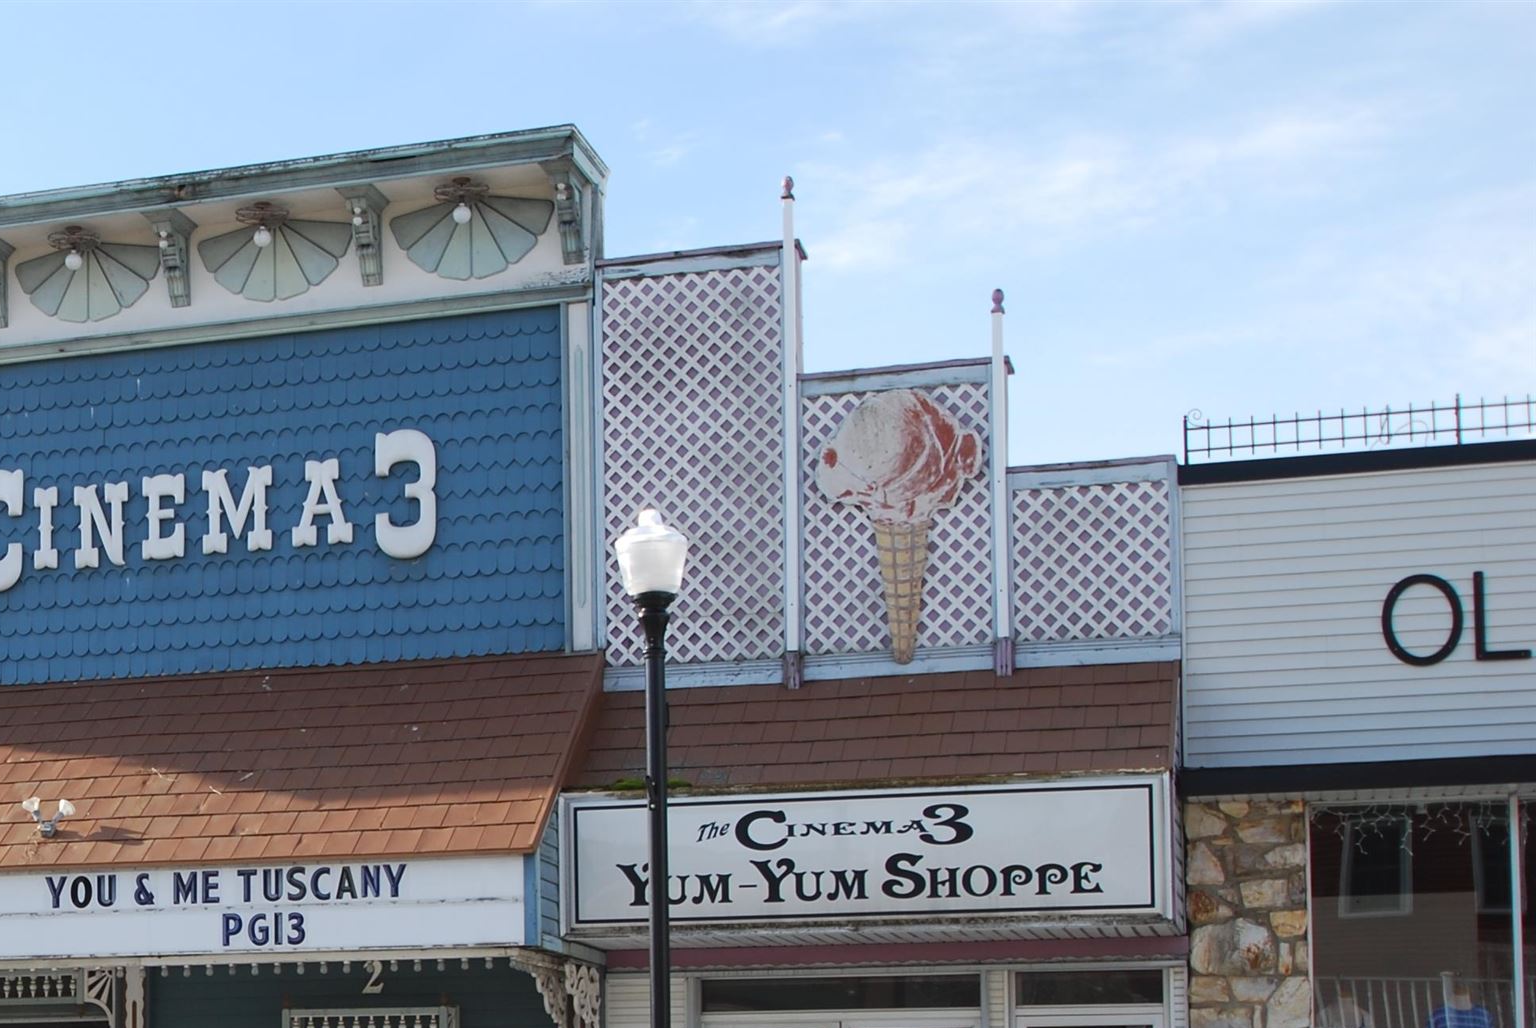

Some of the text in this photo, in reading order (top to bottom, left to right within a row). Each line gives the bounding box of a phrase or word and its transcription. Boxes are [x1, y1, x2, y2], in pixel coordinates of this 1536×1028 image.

[375, 428, 437, 559] 3
[1382, 571, 1532, 666] OL
[696, 819, 731, 844] The
[46, 863, 407, 909] YOU & ME TUSCANY
[221, 912, 307, 947] PG13
